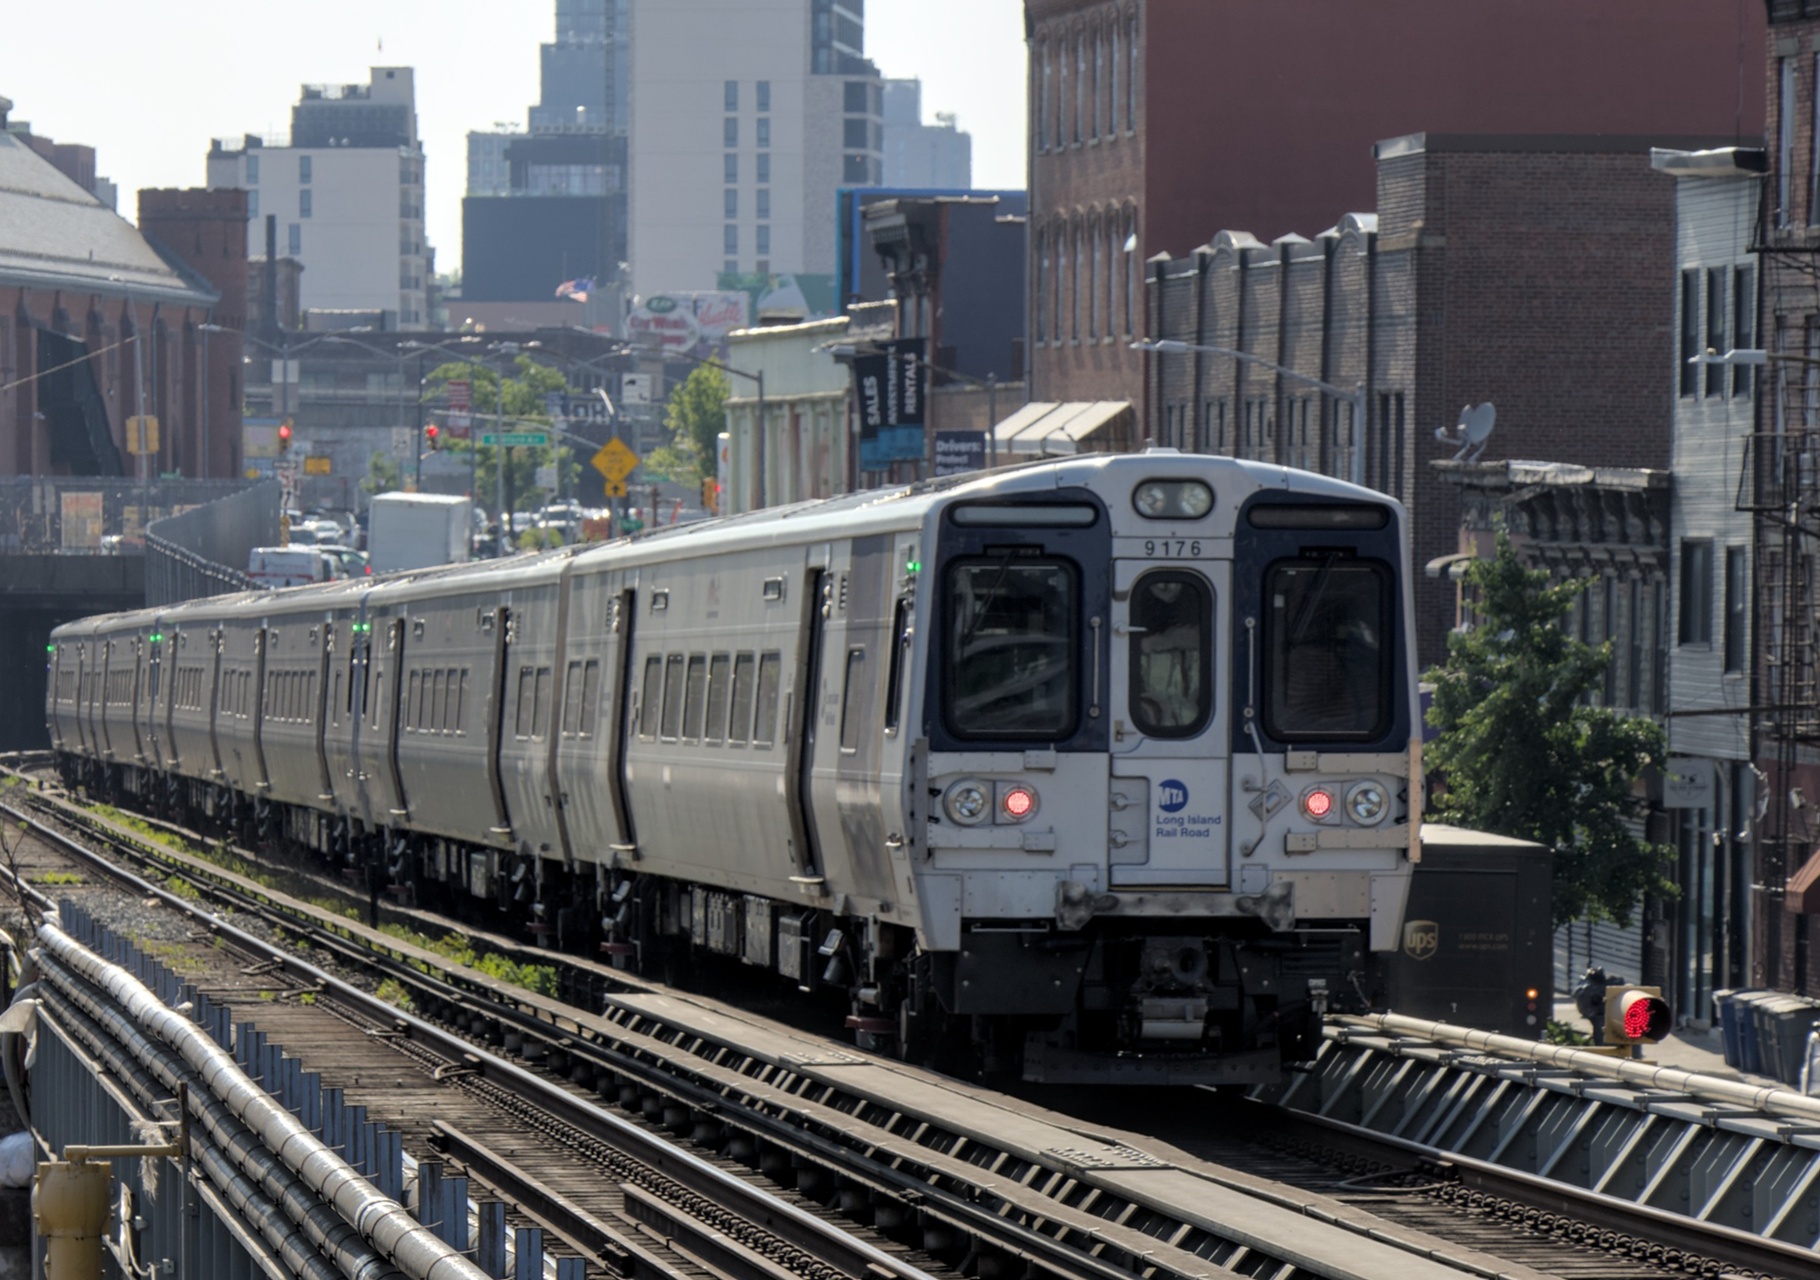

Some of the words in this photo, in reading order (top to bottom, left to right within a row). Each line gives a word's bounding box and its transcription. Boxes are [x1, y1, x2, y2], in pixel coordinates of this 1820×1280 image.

[904, 353, 917, 414] RENTALS
[863, 376, 880, 425] SALES
[1145, 540, 1201, 556] 9176
[1156, 815, 1184, 827] Long
[1187, 815, 1221, 825] Island
[1156, 828, 1177, 837] Rail
[1180, 828, 1209, 837] Road
[1407, 933, 1436, 954] ups
